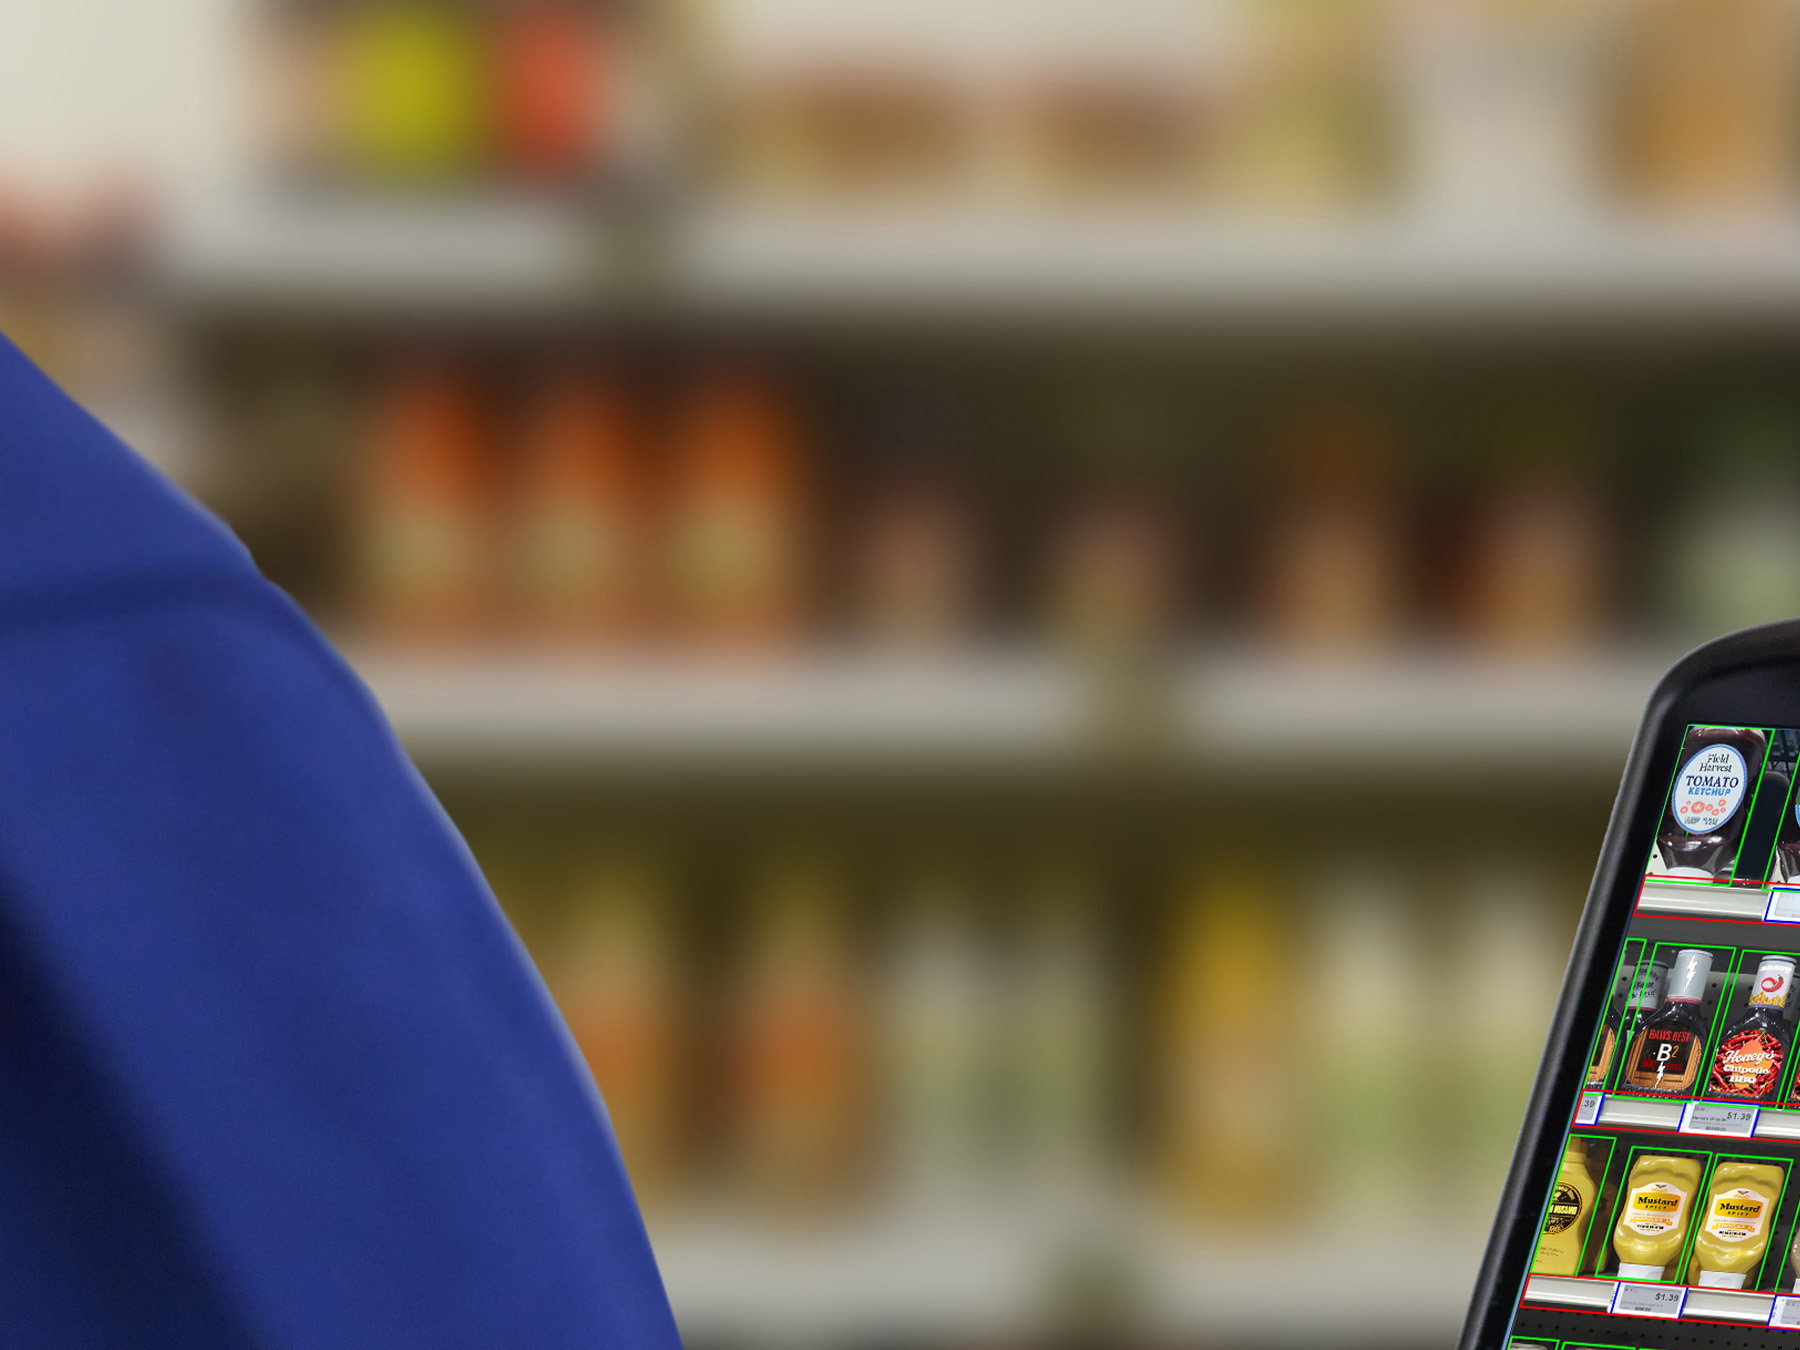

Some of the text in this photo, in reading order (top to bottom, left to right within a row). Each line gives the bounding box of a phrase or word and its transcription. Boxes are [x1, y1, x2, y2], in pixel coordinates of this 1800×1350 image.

[1699, 763, 1732, 772] Harvest
[1686, 775, 1739, 788] TOMATO
[1688, 787, 1731, 796] KETCHUP
[1672, 1031, 1691, 1042] BEST
[1723, 1047, 1775, 1065] Honey's
[1723, 1065, 1769, 1074] Chipotle
[1729, 1075, 1756, 1084] BBQ
[1726, 1111, 1752, 1121] $1.39
[1637, 1196, 1678, 1206] Mustard
[1720, 1203, 1761, 1213] Mustard
[1655, 1292, 1679, 1302] $1.39
